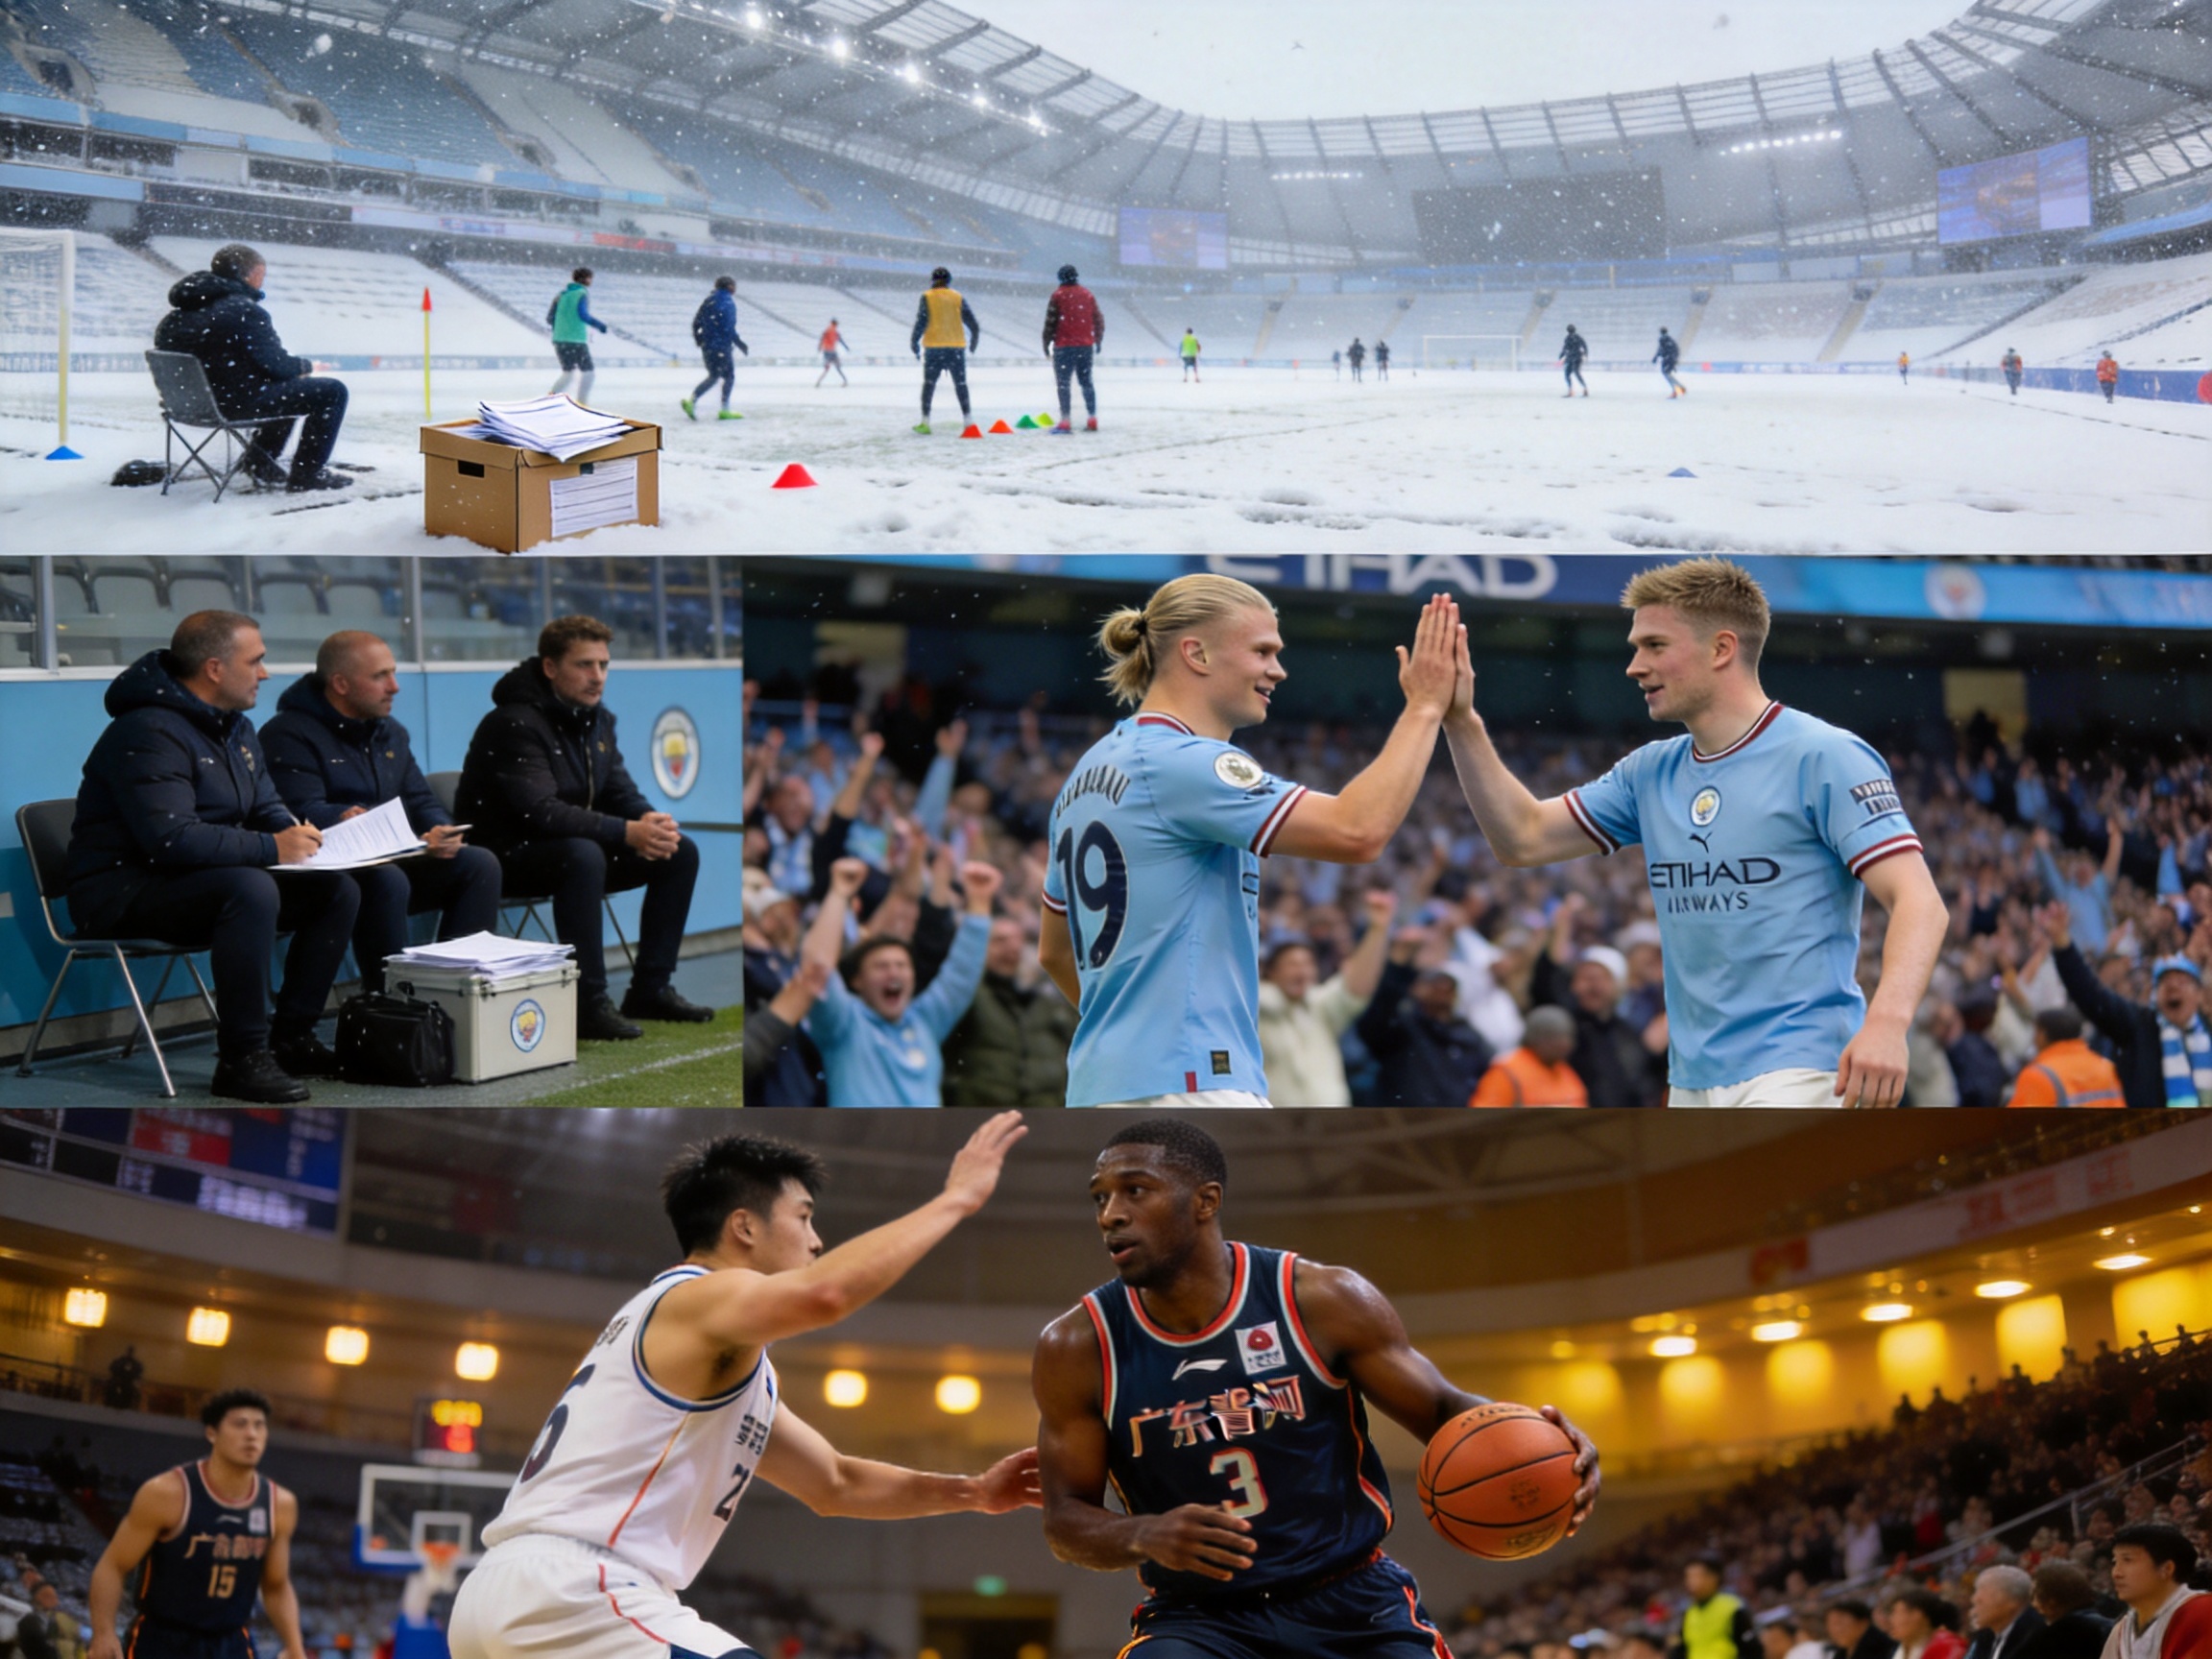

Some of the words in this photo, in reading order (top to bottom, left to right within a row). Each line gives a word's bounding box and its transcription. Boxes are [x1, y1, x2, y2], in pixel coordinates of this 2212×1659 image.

[1057, 820, 1129, 971] 19
[1649, 857, 1781, 888] ETIHAD
[1209, 1447, 1268, 1519] 3
[207, 1565, 237, 1599] 15
